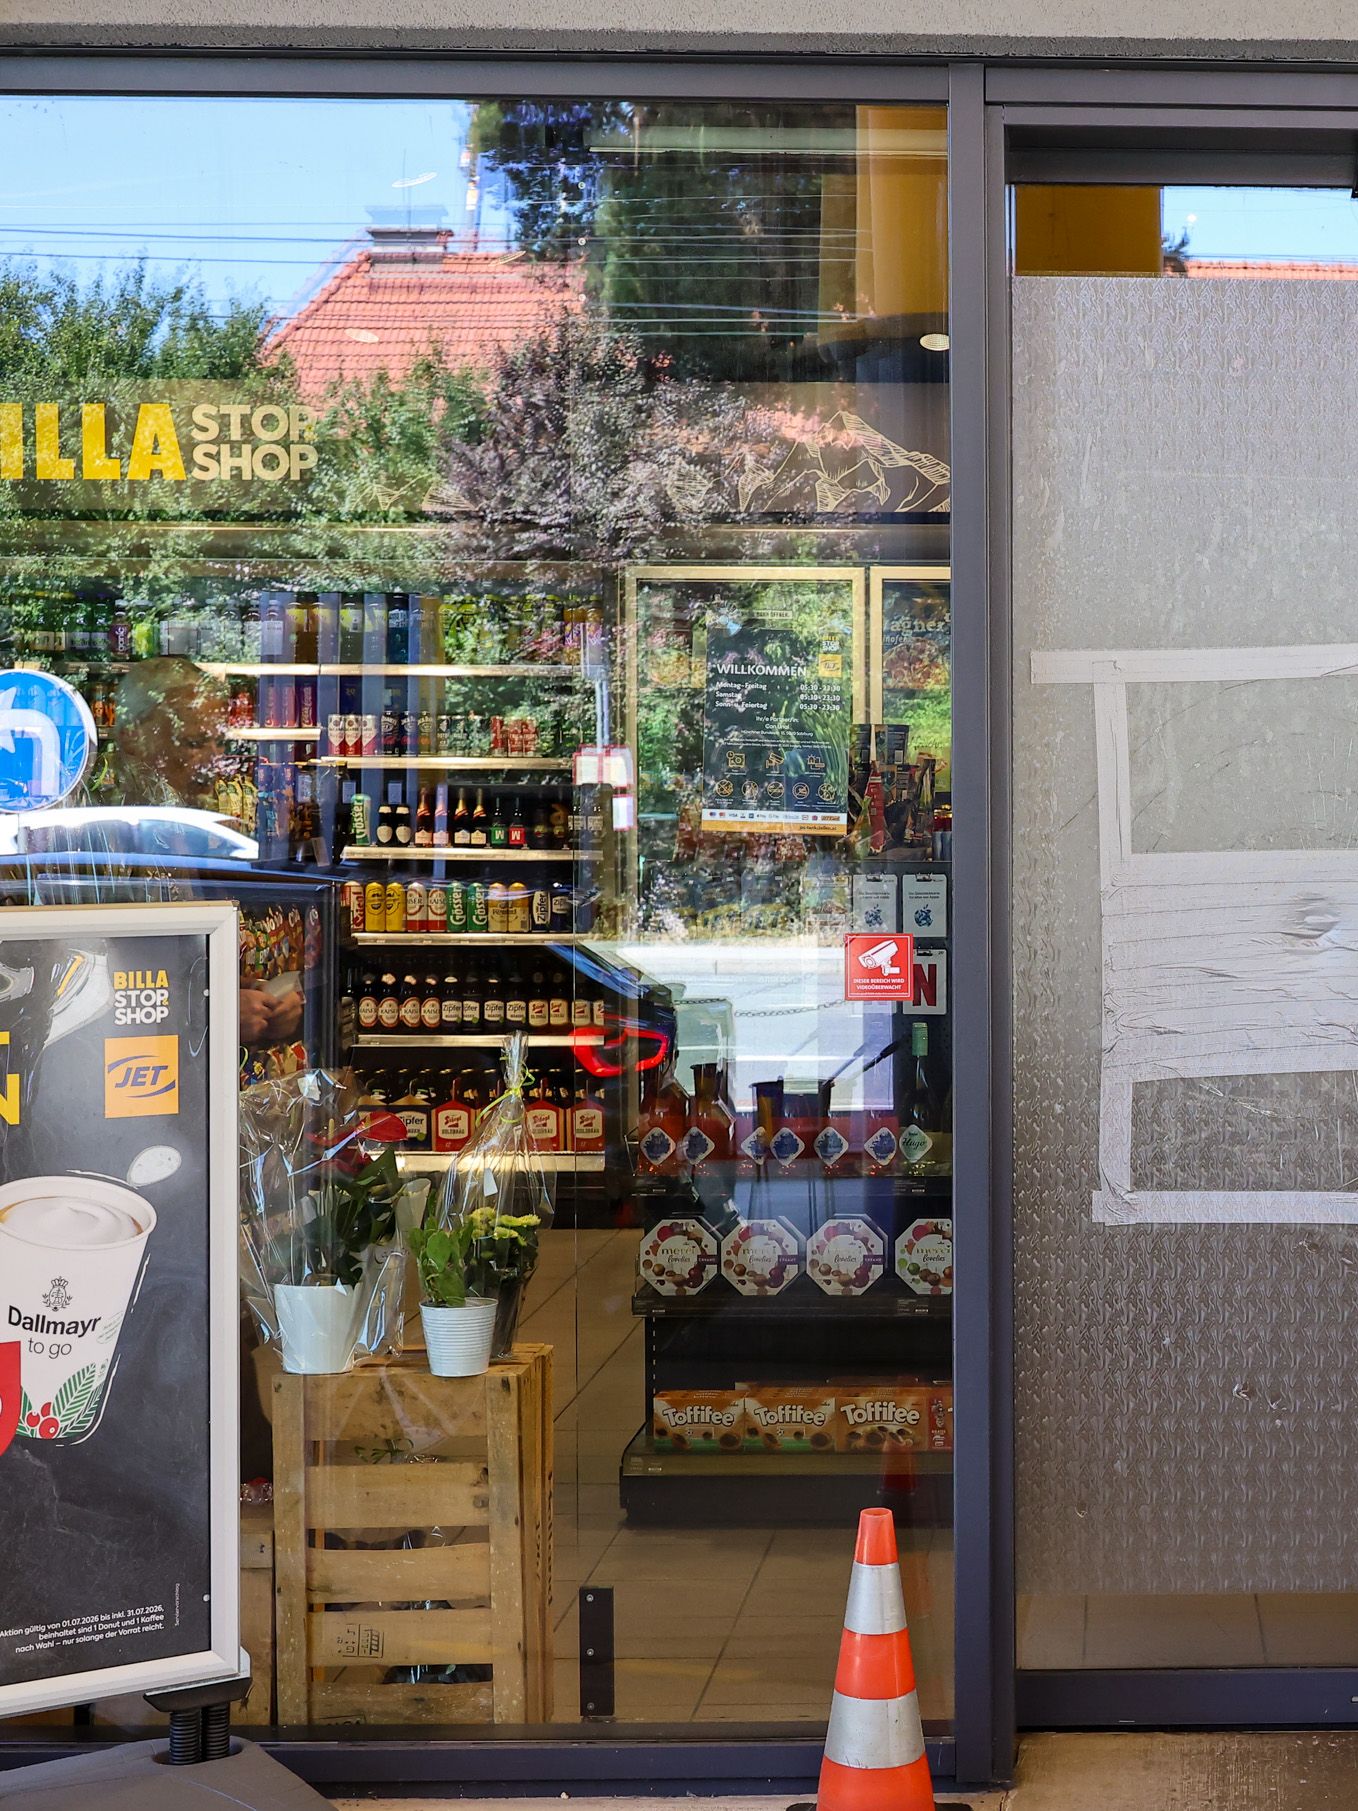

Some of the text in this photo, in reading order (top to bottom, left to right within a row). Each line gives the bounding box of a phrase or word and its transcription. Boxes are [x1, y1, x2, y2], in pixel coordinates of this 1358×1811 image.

[191, 443, 319, 480] SHOP
[717, 663, 807, 677] WILLKOMMEN
[451, 886, 466, 925] Gösser
[472, 886, 487, 925] Gösser
[537, 892, 546, 922] Zipfer
[113, 969, 169, 989] BILLA
[114, 1006, 169, 1025] SHOP
[114, 1064, 168, 1089] JET
[902, 1137, 926, 1150] Hugo
[7, 1305, 101, 1338] Dallmayr
[28, 1337, 72, 1360] to go
[662, 1405, 735, 1427] Toffifee
[754, 1405, 826, 1427] Toffifee
[840, 1401, 920, 1426] Toffifee
[25, 1624, 46, 1636] gültig
[47, 1622, 61, 1630] von
[62, 1615, 99, 1628] 01.07.2026
[100, 1613, 111, 1621] bis
[111, 1611, 126, 1620] inkl.
[39, 1630, 77, 1641] beinhaltet
[78, 1625, 93, 1634] sind
[98, 1621, 120, 1631] Donut
[121, 1618, 135, 1627] und
[140, 1613, 164, 1624] Kaffee
[15, 1643, 35, 1654] nach
[35, 1640, 55, 1650] Wahl
[62, 1638, 75, 1646] nur
[75, 1633, 104, 1645] solange
[105, 1630, 118, 1639] der
[118, 1626, 141, 1636] Vorrat
[141, 1622, 165, 1633] reicht.
